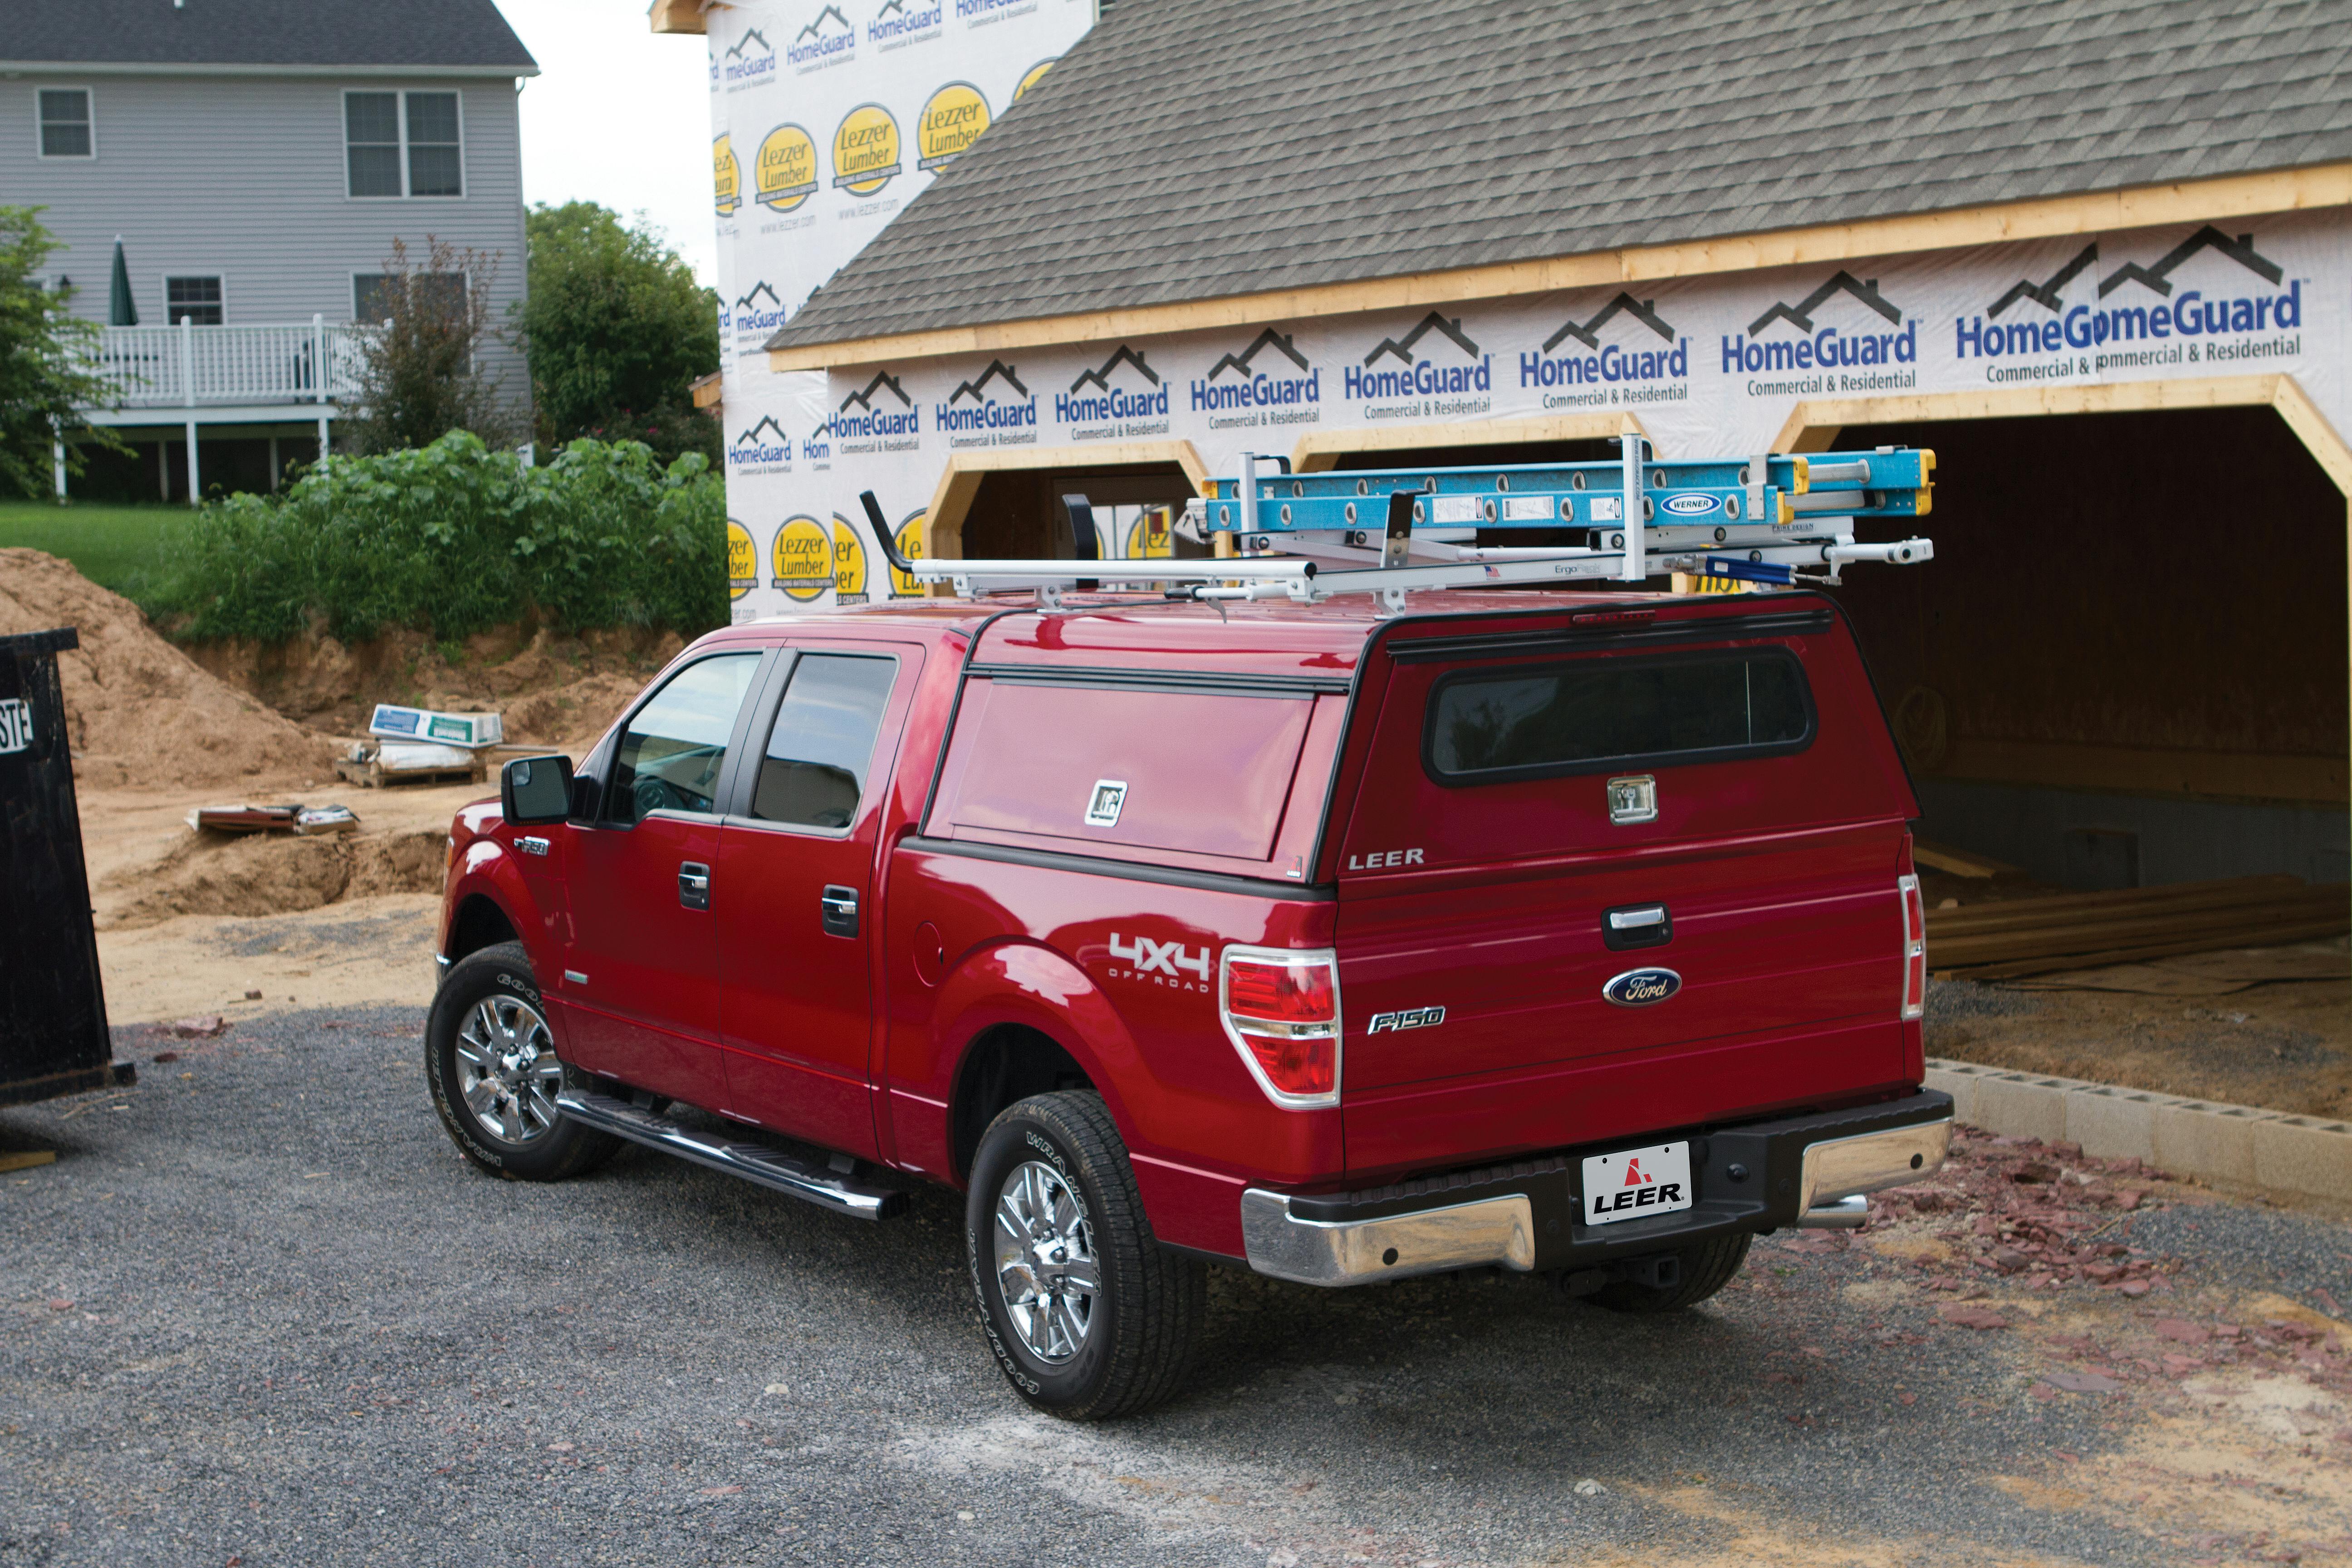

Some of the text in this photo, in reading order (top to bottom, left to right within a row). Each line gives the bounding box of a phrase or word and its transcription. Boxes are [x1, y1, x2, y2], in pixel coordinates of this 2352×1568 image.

[868, 3, 942, 42] HomeGuard
[787, 25, 855, 65] HomeGuard
[926, 102, 980, 131] Lezzer
[841, 122, 890, 150] Lezzer
[763, 142, 808, 168] Lezzer
[843, 142, 889, 172] Lumber
[765, 162, 807, 188] Lumber
[839, 199, 899, 220] www.lezzer.com
[761, 215, 816, 234] www.lezzer.com
[1723, 319, 1916, 373] HomeGuard
[1987, 357, 2073, 382] Commercial
[2079, 357, 2090, 375] &
[2189, 346, 2200, 362] &
[2207, 334, 2301, 360] Residential
[1520, 338, 1688, 387] HomeGuard
[1191, 367, 1319, 411] HomeGuard
[1344, 354, 1490, 399] HomeGuard
[1748, 369, 1916, 396] Commercial & Residential
[1055, 382, 1169, 423] HomeGuard
[1365, 397, 1490, 420] Commercial & Residential
[1543, 384, 1688, 409] Commercial & Residential
[828, 404, 918, 439] HomeGuard
[936, 394, 1037, 431] HomeGuard
[1209, 407, 1319, 429] Commercial & Residential
[950, 430, 1037, 448] Commercial & Residential
[1072, 420, 1169, 441] Commercial & Residential
[729, 440, 792, 465] HomeGuard
[840, 438, 919, 454] Commercial & Residential
[738, 466, 762, 475] Commercial
[768, 463, 792, 474] Residential
[1673, 500, 1709, 509] WERNER
[779, 533, 824, 554] Lezzer
[782, 554, 823, 575] Lumber
[1348, 848, 1425, 871] LEER
[1154, 976, 1209, 993] ROAD
[1626, 975, 1668, 1000] Ford
[1594, 1183, 1681, 1214] LEER
[1025, 1131, 1102, 1298] WRANGLER
[968, 1227, 1040, 1396] GOODYEAR
